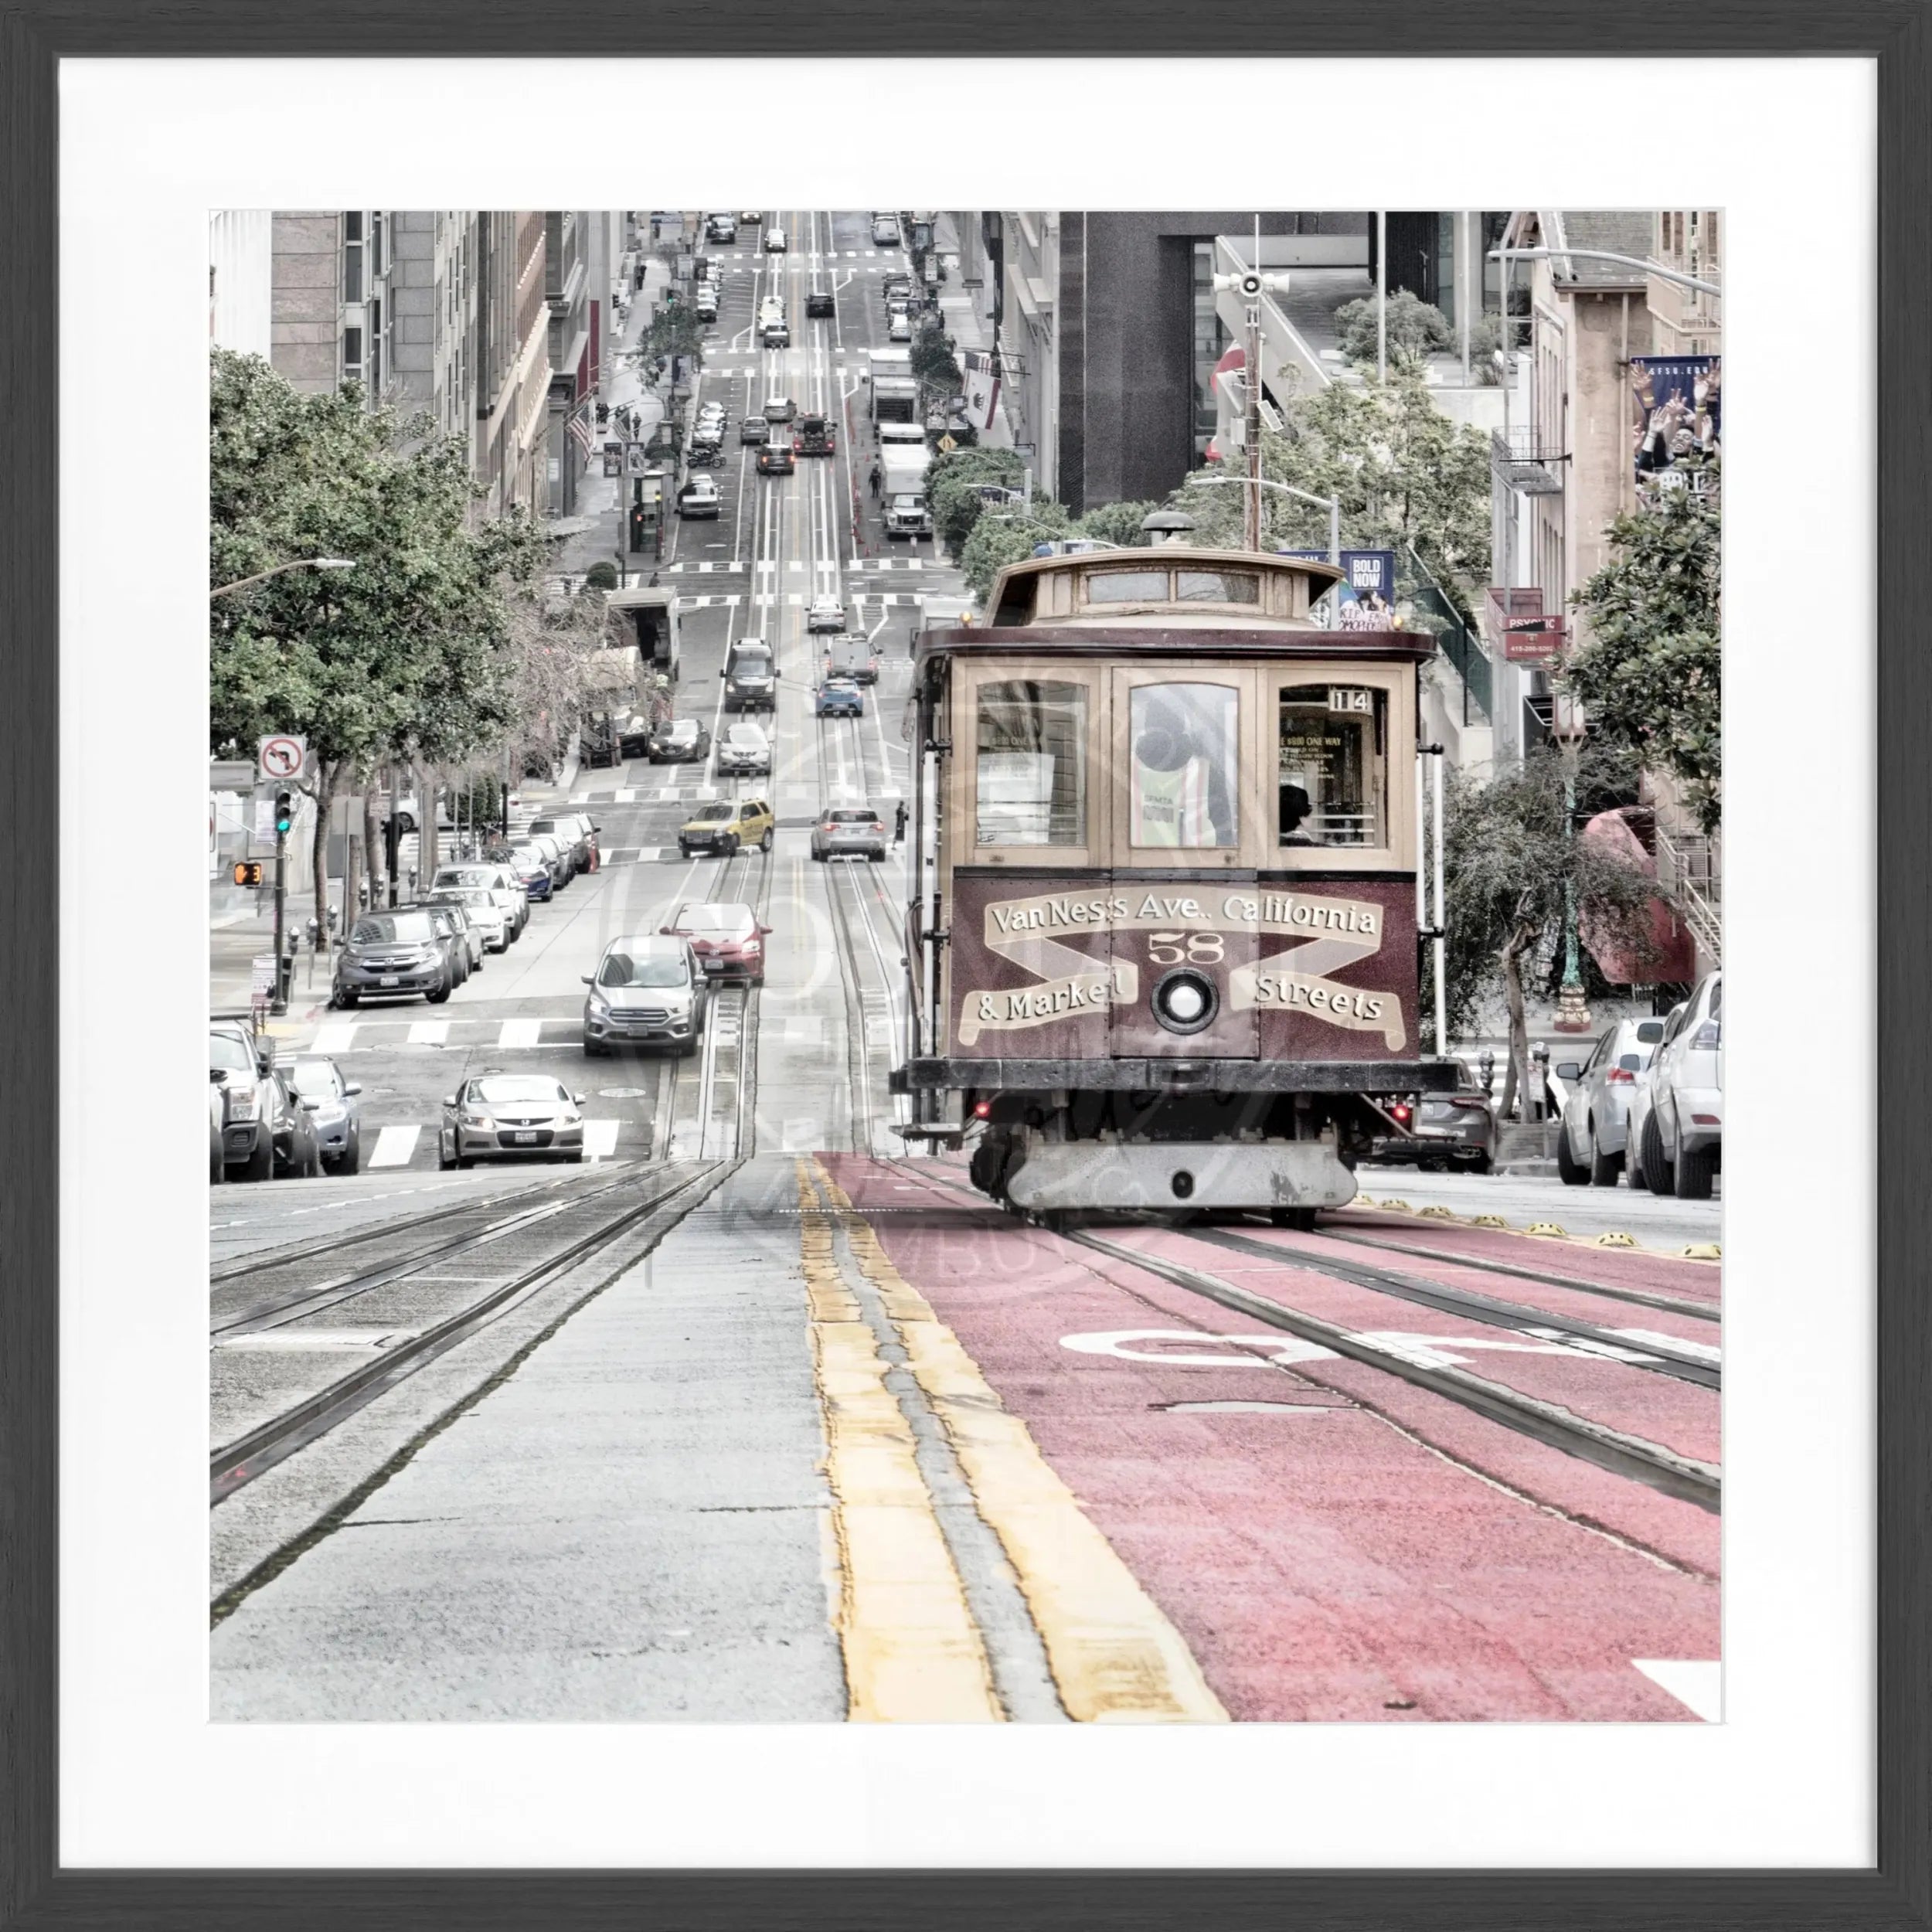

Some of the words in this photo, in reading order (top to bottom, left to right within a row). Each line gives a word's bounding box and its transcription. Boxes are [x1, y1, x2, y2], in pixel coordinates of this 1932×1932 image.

[1650, 366, 1709, 376] SFSU.EDU
[1352, 560, 1380, 573] BOLD
[1352, 573, 1380, 587] NOW
[1509, 618, 1555, 629] PSYCIC
[1335, 692, 1368, 710] 14
[1306, 736, 1322, 746] ONE
[1325, 736, 1342, 746] WAY
[253, 866, 260, 882] 3
[1223, 896, 1377, 935] California
[1148, 933, 1225, 964] 58
[978, 993, 1001, 1021] &
[1007, 969, 1125, 1022] Market
[1254, 975, 1386, 1022] Streets
